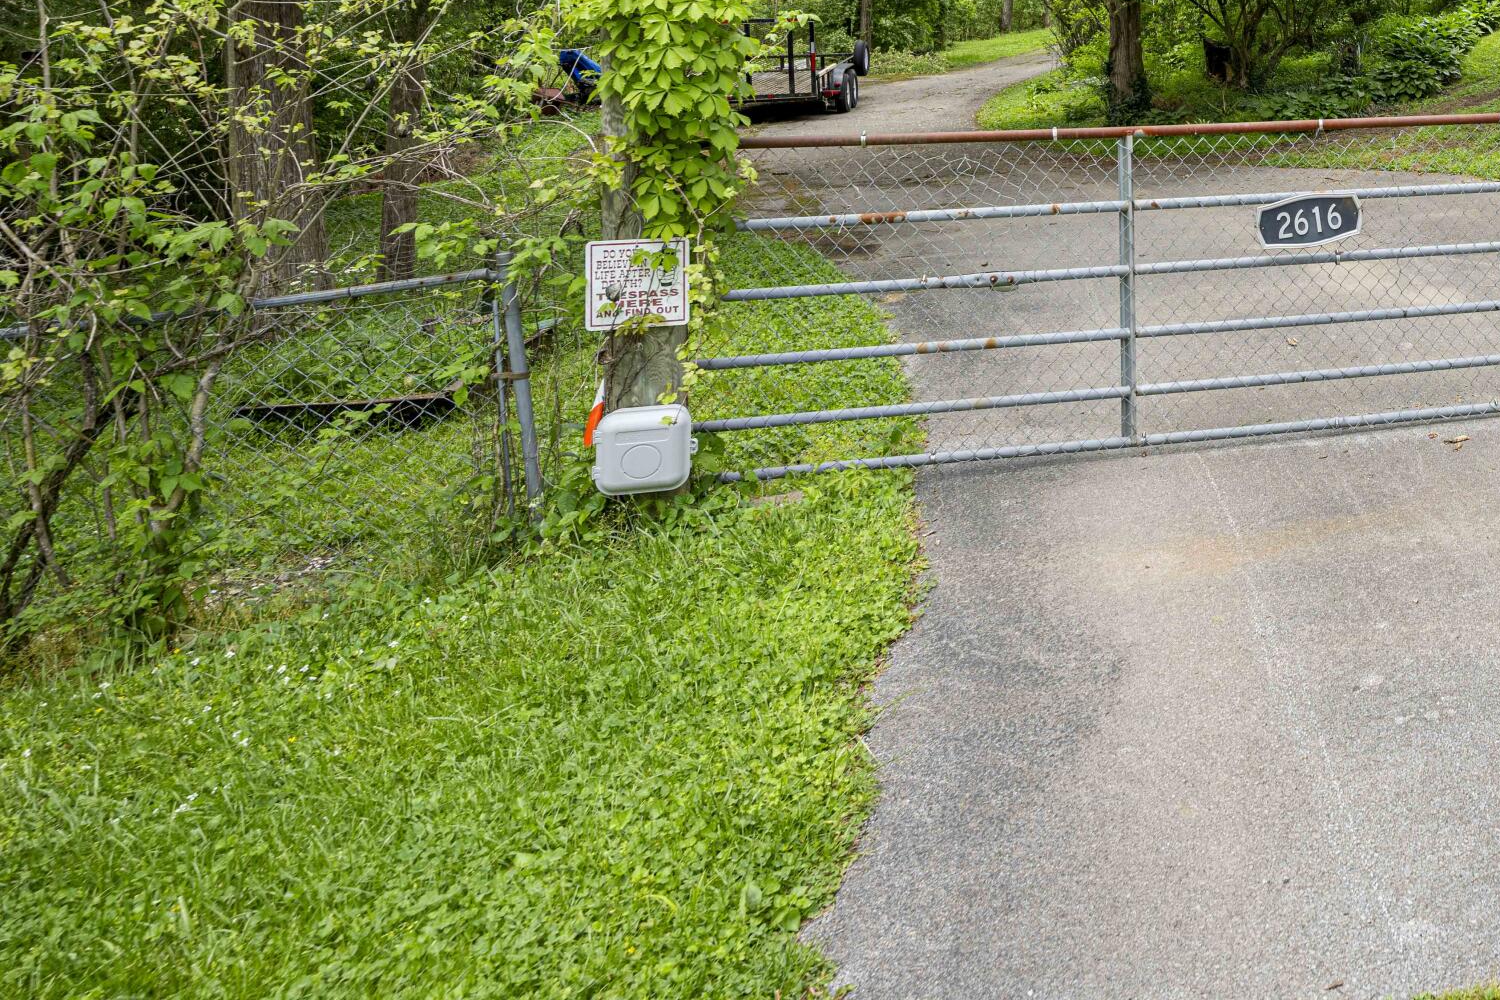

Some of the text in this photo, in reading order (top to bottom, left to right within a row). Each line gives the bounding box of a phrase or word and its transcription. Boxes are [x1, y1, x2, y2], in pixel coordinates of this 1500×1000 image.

[1276, 203, 1342, 240] 2616
[603, 250, 616, 259] DO
[595, 268, 651, 280] LIFE AFTER
[596, 288, 679, 301] TESPASS
[625, 308, 651, 317] FIND
[656, 305, 679, 314] OUT
